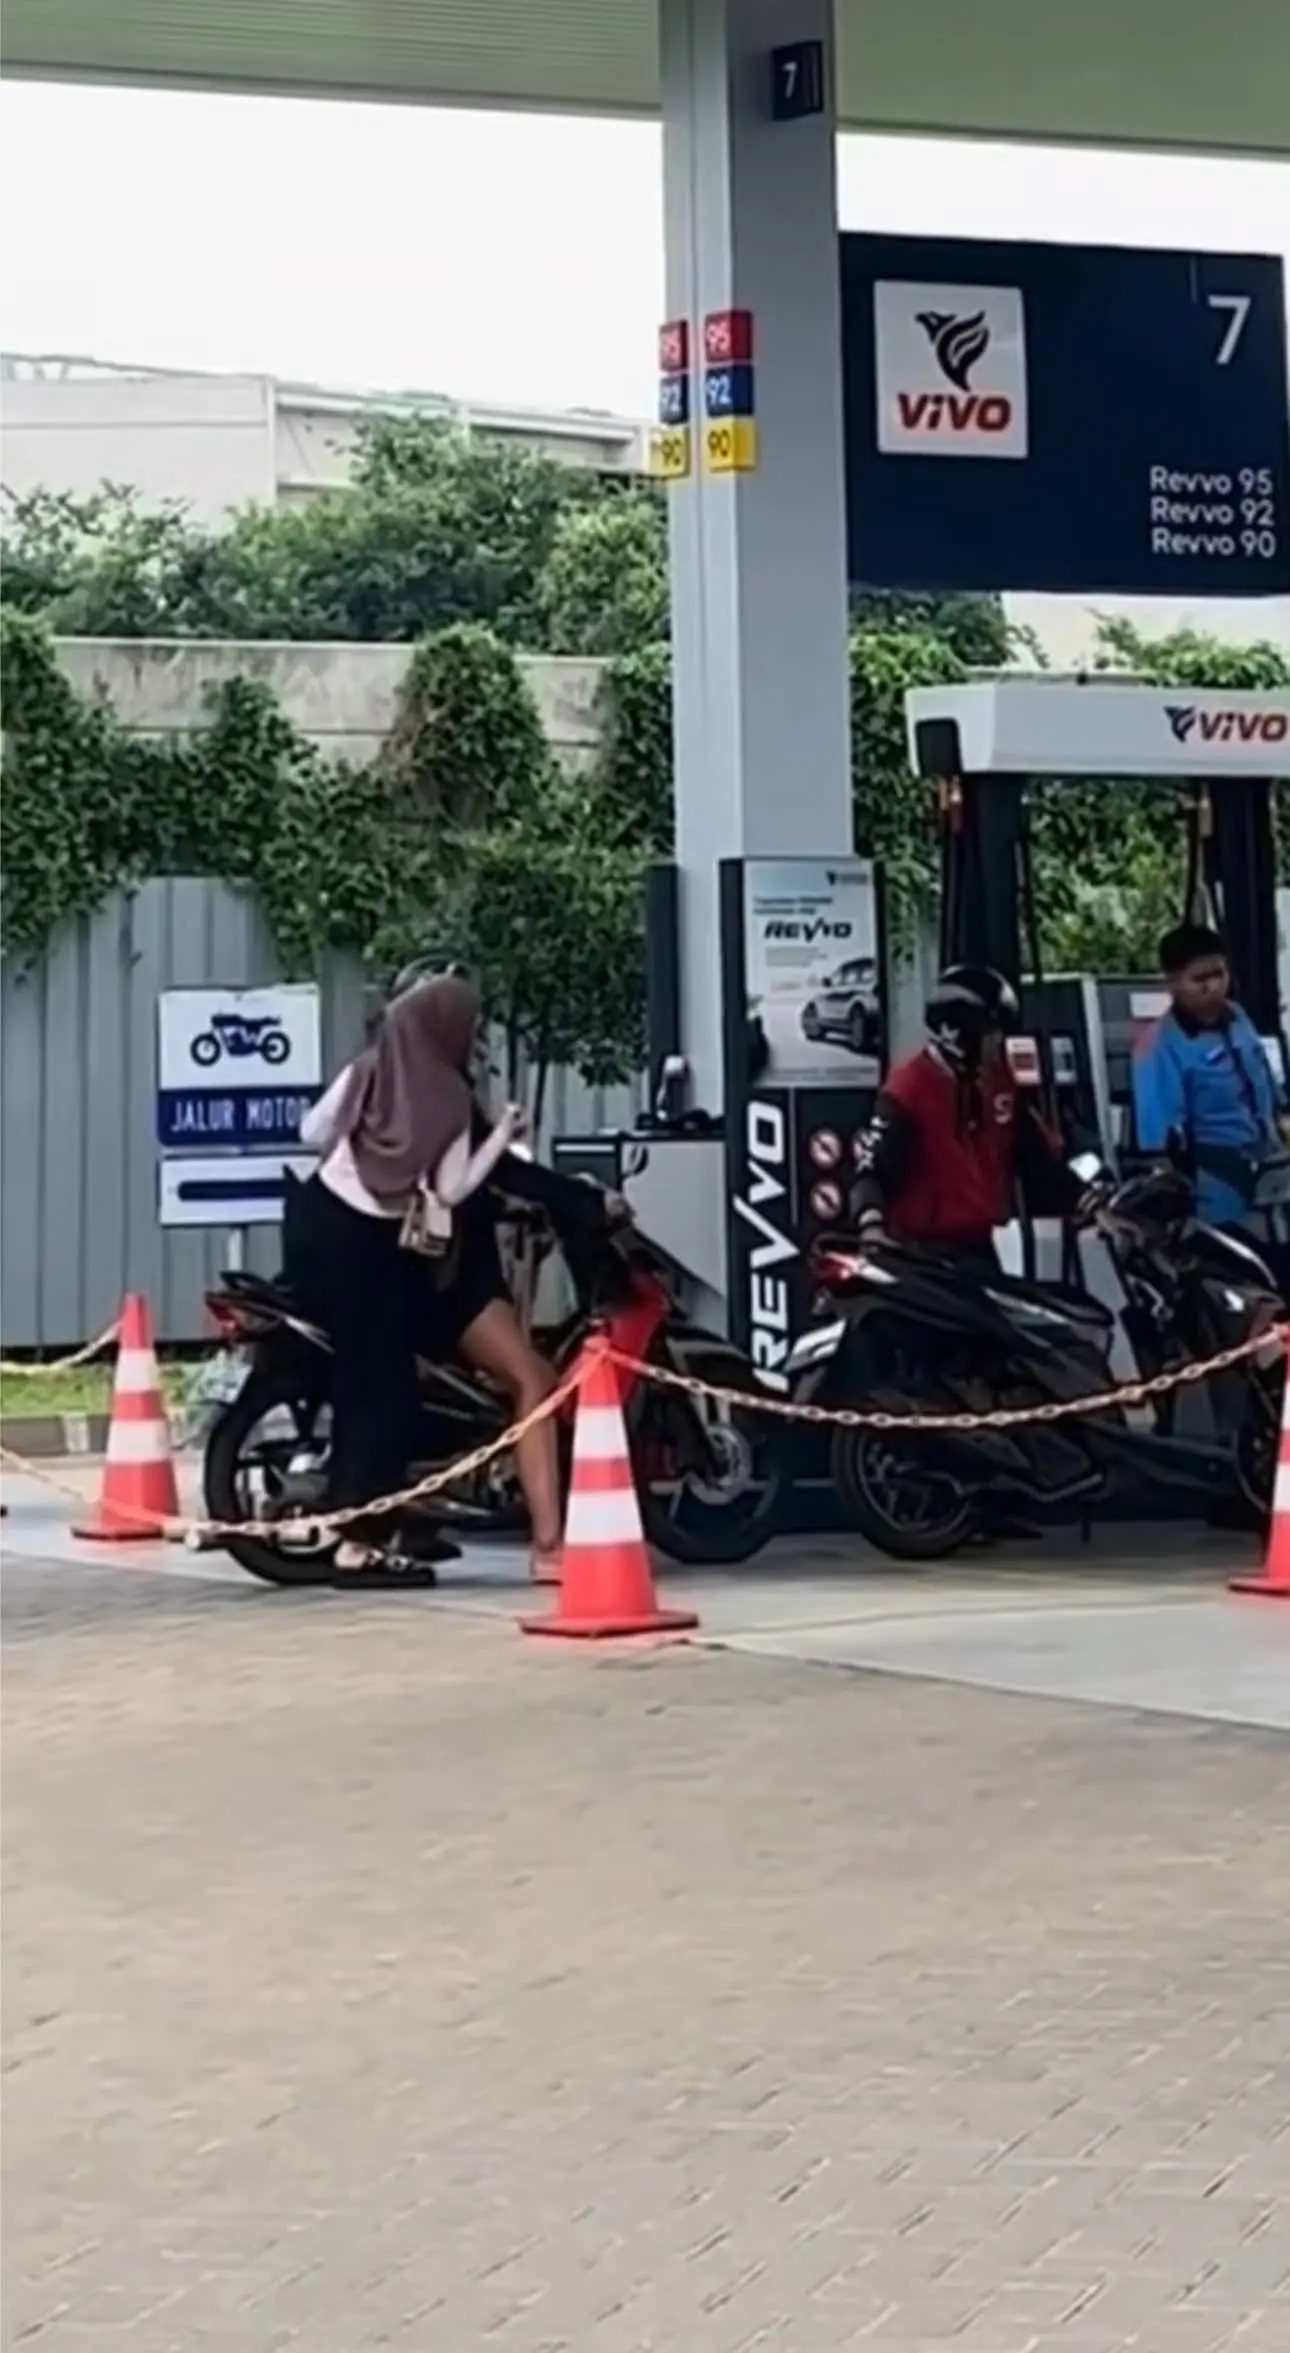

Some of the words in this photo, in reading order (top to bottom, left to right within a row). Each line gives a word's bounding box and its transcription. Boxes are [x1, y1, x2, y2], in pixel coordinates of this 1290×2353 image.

[781, 61, 798, 99] 7
[705, 320, 731, 353] 95
[1207, 295, 1251, 365] 7
[706, 376, 731, 406] 92
[708, 429, 731, 458] 90
[1150, 466, 1232, 495] Revvo
[1238, 469, 1273, 495] 95
[1150, 497, 1233, 526] Revvo
[1240, 500, 1275, 527] 92
[1152, 529, 1235, 557] Revvo
[1240, 531, 1277, 558] 90
[171, 1099, 235, 1133] JALUR
[732, 1100, 799, 1393] REVVO
